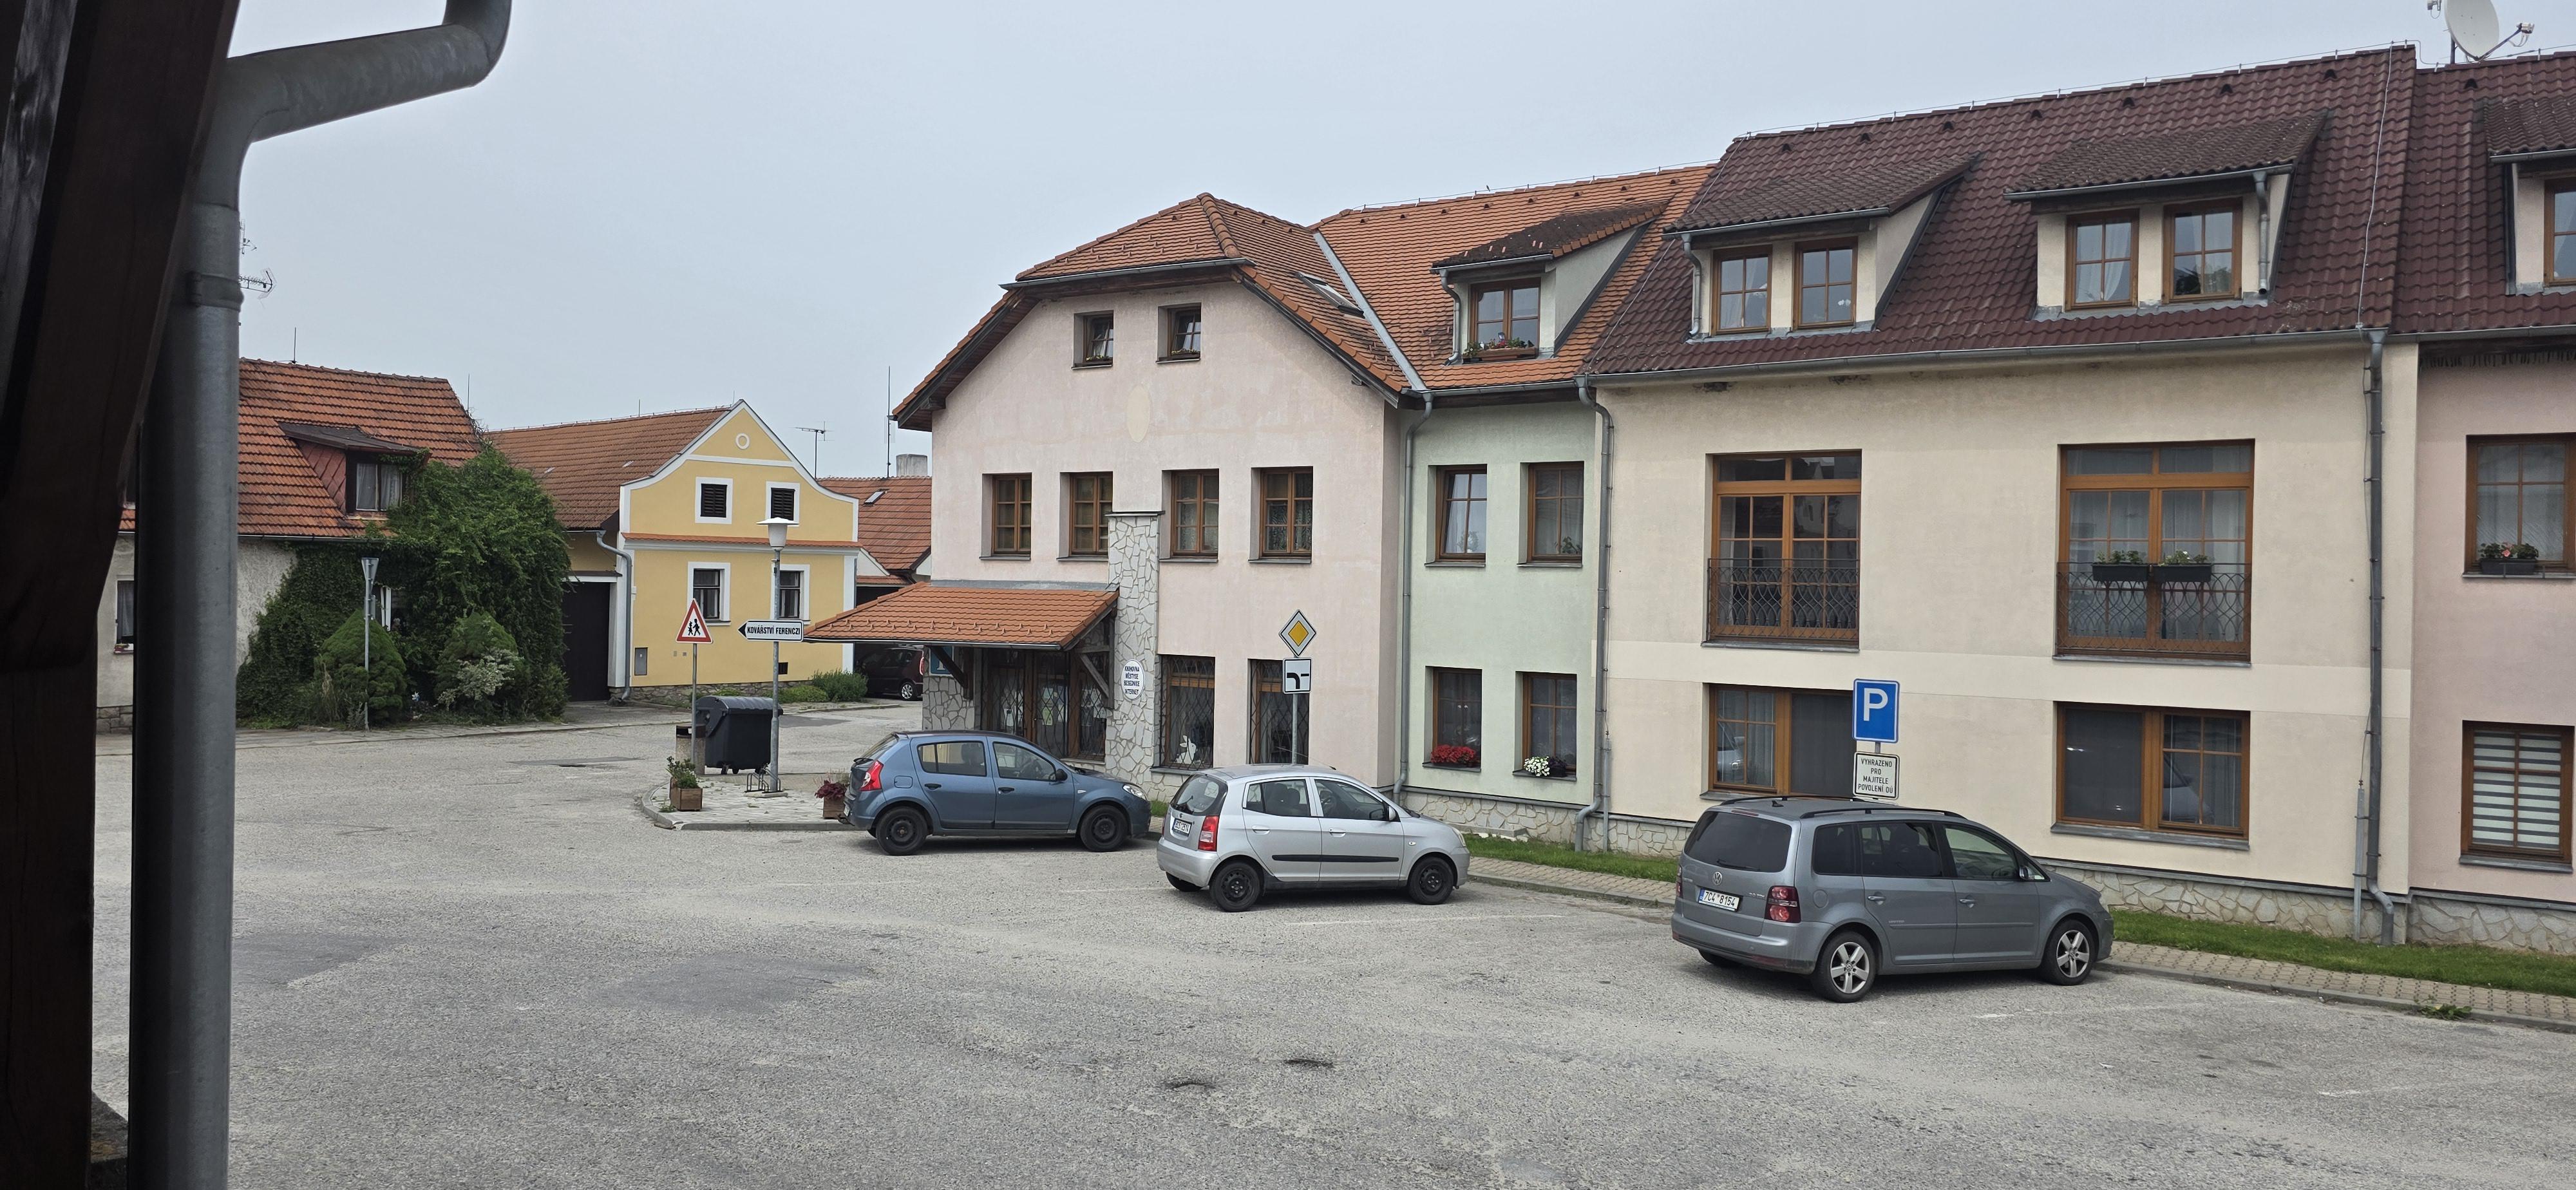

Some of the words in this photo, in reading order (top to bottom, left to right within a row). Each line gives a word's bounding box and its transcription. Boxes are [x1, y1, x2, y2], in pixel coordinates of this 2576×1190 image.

[747, 625, 774, 634] KOVÁŘSTVÍ
[1863, 688, 1888, 721] P
[1861, 758, 1892, 768] VYHRAZENO
[1863, 775, 1888, 784] MAJITELE
[1858, 783, 1884, 792] POVOLENÍ
[1703, 891, 1716, 902] 7C4
[1719, 895, 1736, 907] 8154
